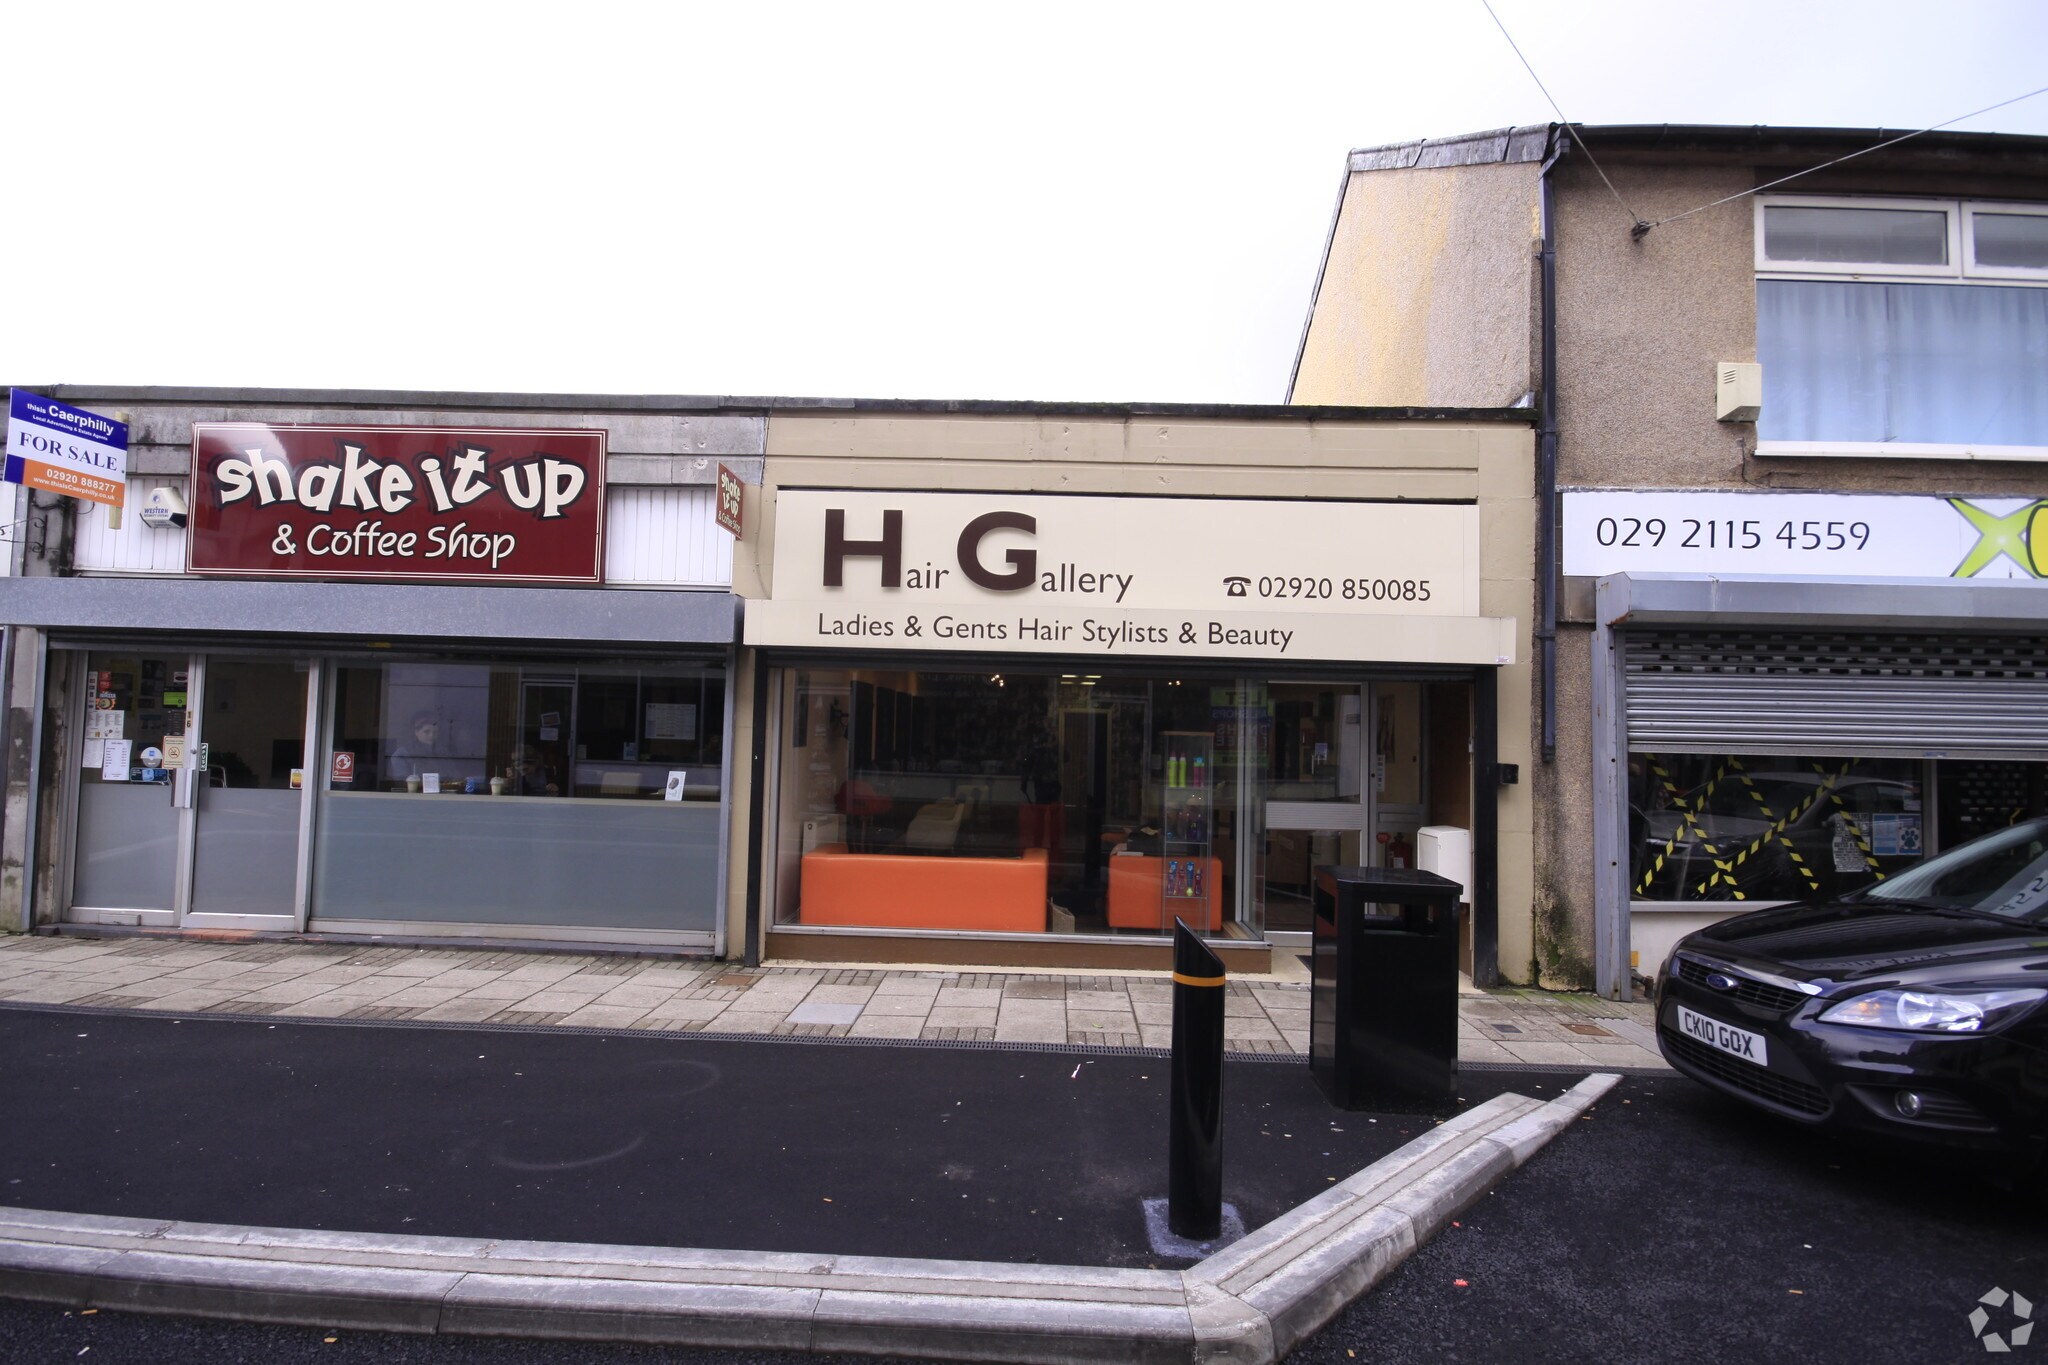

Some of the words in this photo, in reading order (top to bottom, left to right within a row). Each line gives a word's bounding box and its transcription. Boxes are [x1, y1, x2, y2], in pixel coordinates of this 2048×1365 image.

[32, 414, 46, 423] Local
[47, 419, 73, 432] Advertising
[78, 428, 92, 436] Estate
[93, 433, 108, 441] Agents
[49, 405, 114, 436] Caerphilly
[20, 432, 62, 456] FOR
[68, 446, 118, 471] SALE
[46, 469, 78, 484] 02920
[81, 477, 116, 493] 888277
[216, 445, 414, 513] shake
[420, 448, 492, 511] it
[500, 458, 585, 518] up
[272, 524, 296, 556] &
[307, 521, 418, 557] Coffee
[425, 522, 515, 568] Shop
[1596, 517, 1667, 548] 029
[1680, 519, 1762, 550] 2115
[1776, 521, 1870, 550] 4559
[823, 508, 950, 590] Hair
[956, 510, 1134, 603] Gallery
[1258, 576, 1332, 599] 02920
[1342, 579, 1432, 601] 850085
[818, 613, 894, 636] Ladies
[904, 615, 922, 638] &
[933, 615, 1008, 640] Gents
[1018, 618, 1073, 641] Hair
[1082, 620, 1168, 649] Stylists
[1178, 622, 1197, 644] &
[1208, 622, 1294, 652] Beauty
[1684, 1012, 1715, 1042] CK10
[1719, 1026, 1754, 1058] GOX
